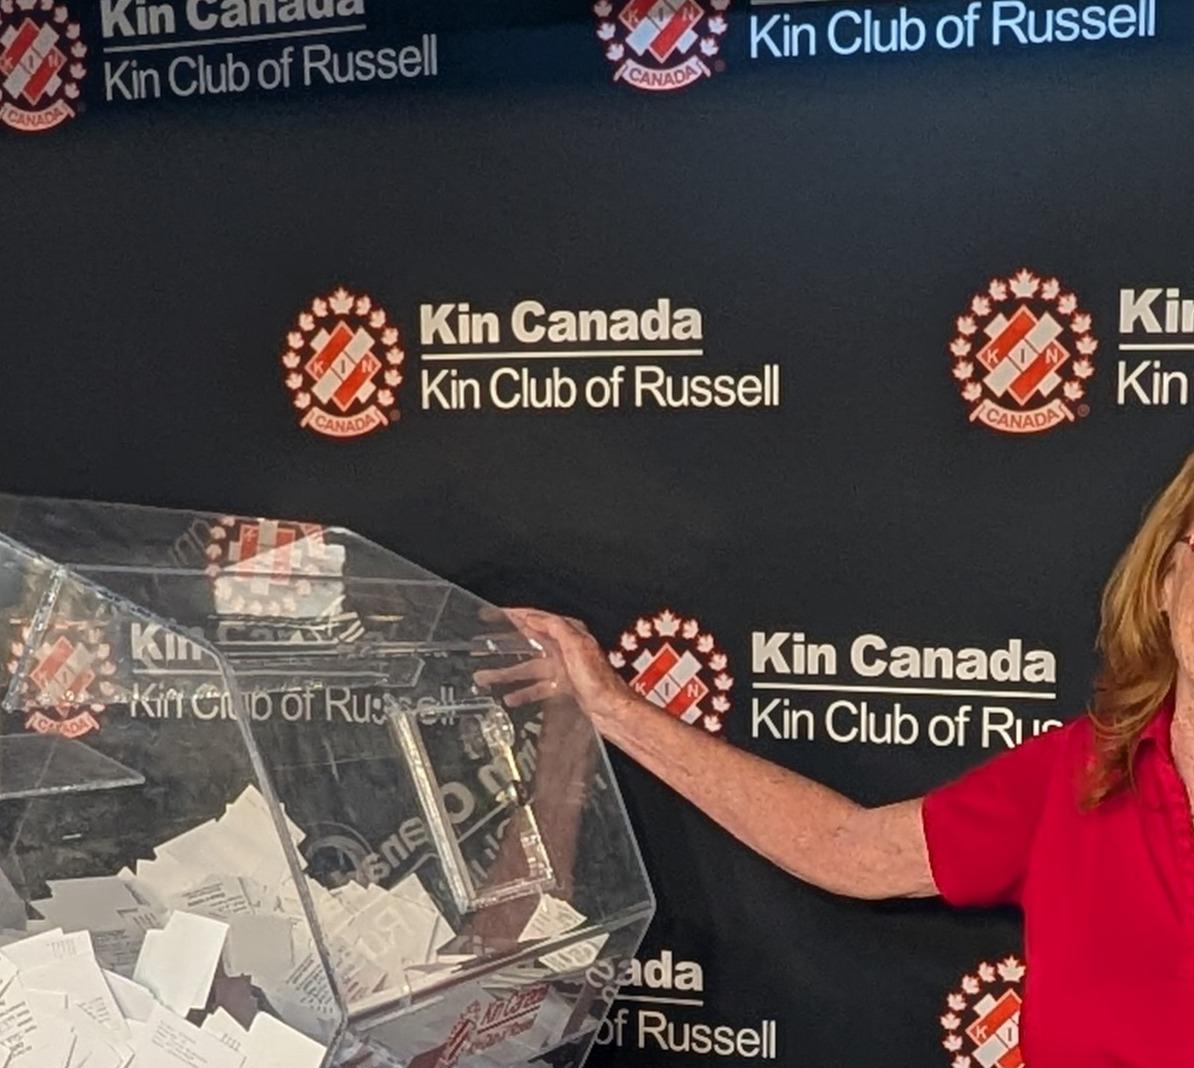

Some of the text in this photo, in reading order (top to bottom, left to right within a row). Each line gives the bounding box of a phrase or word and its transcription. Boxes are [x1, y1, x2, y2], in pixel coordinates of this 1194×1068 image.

[100, 0, 366, 38] Kin Canada
[750, 0, 1156, 59] Kin Club of Russell
[104, 34, 438, 101] Kin Club of Russell
[628, 64, 698, 86] CANADA
[420, 298, 703, 345] Kin Canada
[421, 364, 780, 410] Kin Club of Russell
[1117, 360, 1188, 406] Kin
[315, 413, 376, 433] CANADA
[986, 407, 1060, 429] CANADA
[752, 631, 1056, 683] Kin Canada
[130, 683, 183, 718] Kin
[280, 685, 316, 720] of
[752, 698, 814, 740] Kin
[825, 700, 918, 746] Club
[928, 705, 971, 747] of
[618, 949, 704, 992] ada
[638, 1010, 776, 1059] Russell
